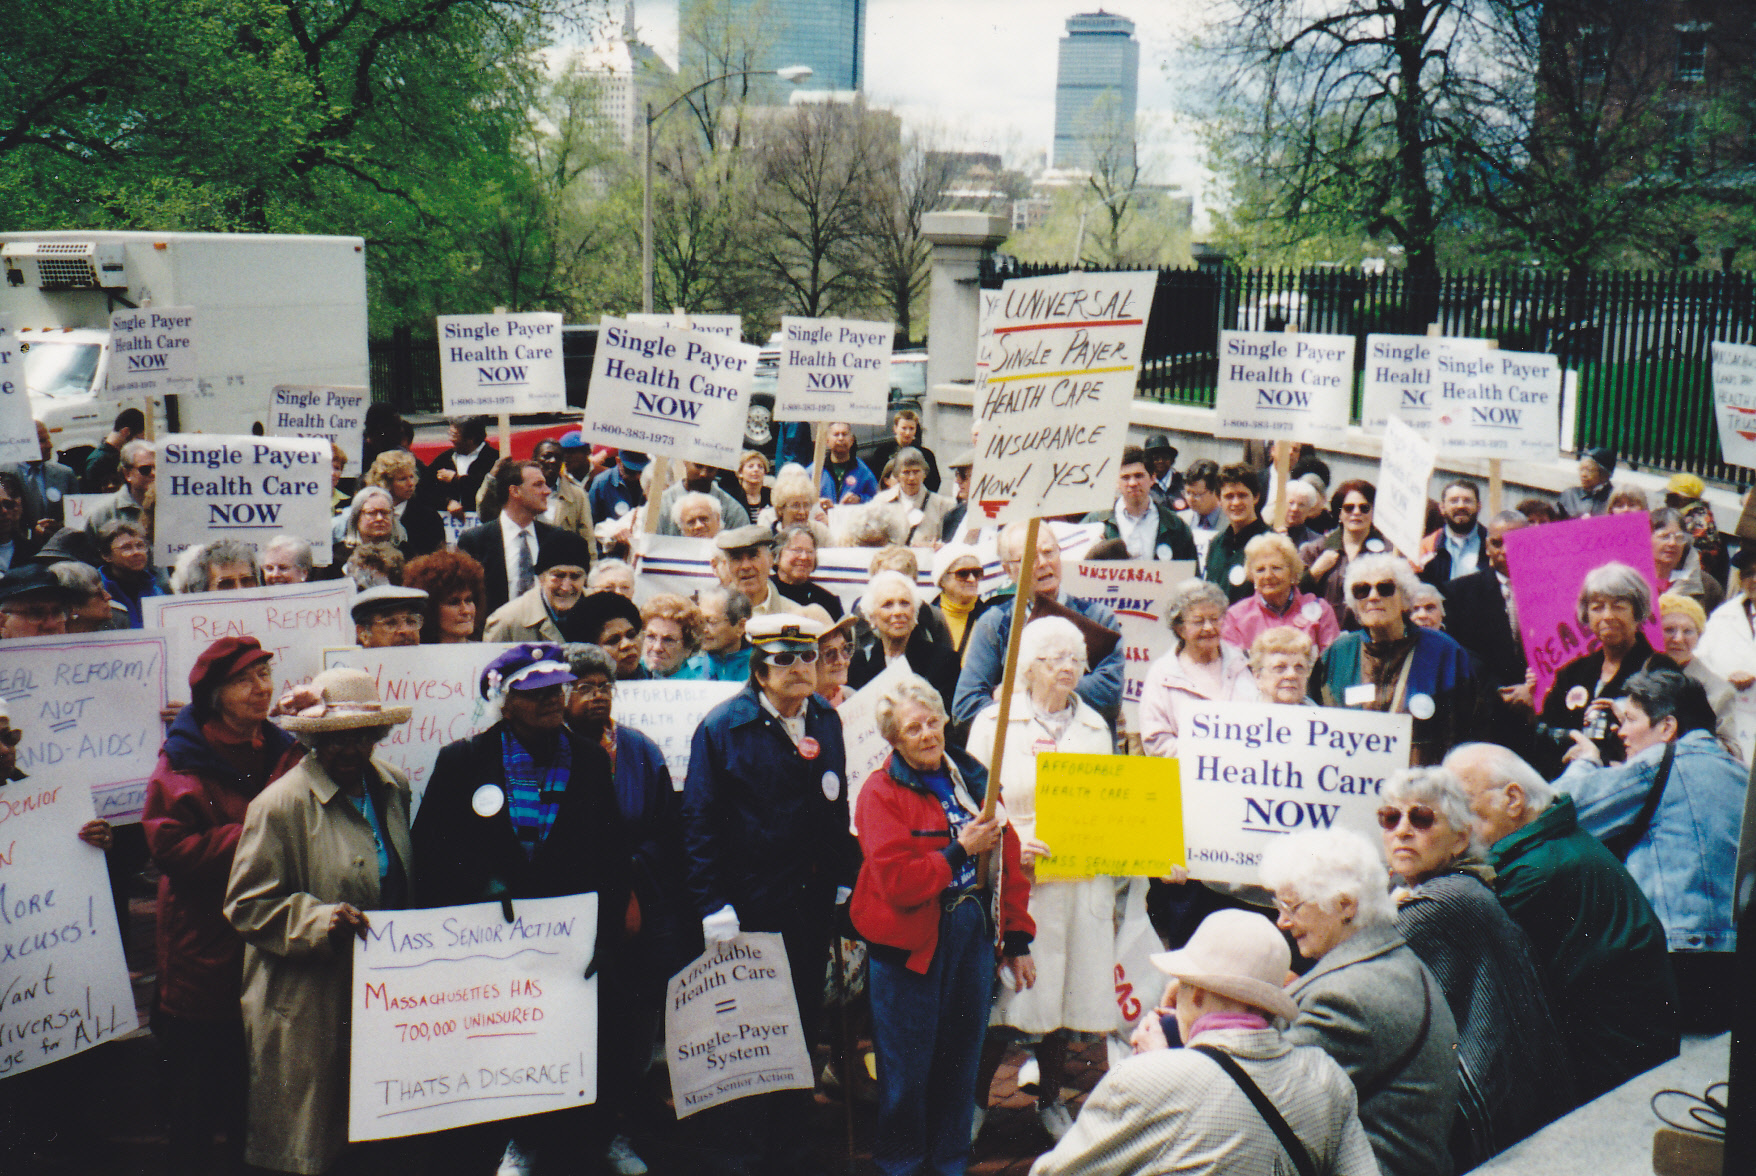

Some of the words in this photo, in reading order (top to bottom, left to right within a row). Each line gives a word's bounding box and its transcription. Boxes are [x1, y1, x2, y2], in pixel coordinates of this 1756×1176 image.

[1005, 289, 1136, 320] UNIVERSAL
[113, 315, 146, 331] Single
[151, 314, 191, 330] Payer
[445, 322, 499, 341] Single
[506, 321, 554, 339] Payer
[115, 335, 152, 352] Health
[157, 335, 190, 349] Care
[787, 325, 833, 346] Single
[840, 327, 886, 348] Payer
[450, 345, 508, 362] Health
[515, 345, 552, 360] Care
[605, 326, 677, 358] Single
[684, 341, 748, 372] Payer
[789, 350, 836, 367] Health
[842, 352, 881, 369] Care
[992, 333, 1052, 373] SINGLE
[1060, 328, 1128, 369] PAYER
[1227, 338, 1288, 360] Single
[1296, 342, 1346, 363] Payer
[1373, 342, 1431, 362] Single
[128, 354, 168, 370] NOW
[478, 366, 528, 382] NOW
[1437, 354, 1494, 378] Single
[1501, 358, 1550, 380] Payer
[604, 358, 680, 390] Health
[689, 374, 738, 401] Care
[806, 373, 855, 389] NOW
[1230, 364, 1293, 384] Health
[1301, 368, 1341, 388] Care
[276, 390, 321, 407] Single
[327, 392, 362, 409] Payer
[981, 382, 1047, 421] HEALTH
[1256, 388, 1313, 408] NOW
[1442, 381, 1502, 401] Health
[1508, 385, 1549, 404] Care
[634, 390, 704, 421] NOW
[1471, 406, 1523, 425] NOW
[278, 413, 324, 428] Health
[329, 414, 358, 428] Care
[592, 422, 675, 446] 1-800-383-1973
[165, 443, 243, 469] Single
[252, 444, 322, 469] Payer
[170, 476, 253, 496] Health
[262, 476, 319, 496] Care
[971, 463, 1032, 500] NOW!
[1043, 457, 1110, 498] YES!
[208, 503, 282, 523] NOW
[1078, 564, 1163, 584] UNIVERSAL
[192, 615, 253, 640] REAL
[266, 606, 342, 631] REFORM
[0, 667, 39, 692] EAL
[55, 651, 158, 687] REFORM!
[40, 697, 95, 720] NOT
[618, 713, 674, 726] HEALTH
[373, 716, 443, 749] ealth
[1191, 713, 1292, 749] Single
[1305, 719, 1398, 757] Payer
[15, 730, 147, 768] AND-AIDS!
[1041, 759, 1126, 776] AFFORDABLE
[1195, 754, 1304, 790] Health
[1040, 784, 1091, 799] HEALTH
[1100, 787, 1131, 801] CARE
[1242, 797, 1341, 830] NOW
[442, 917, 504, 947] SENIOR
[509, 916, 577, 940] ACTION
[510, 980, 543, 999] HAS
[675, 971, 726, 1011] Health
[732, 964, 776, 981] Care
[74, 1004, 127, 1050] ALL
[394, 1020, 457, 1043] 700,000
[463, 1007, 545, 1030] UNINSURED
[678, 1023, 789, 1060] Single-Payer
[705, 1044, 771, 1070] System
[457, 1073, 470, 1093] A
[684, 1091, 714, 1107] Mass
[716, 1077, 753, 1095] Senior
[757, 1071, 794, 1085] Action
